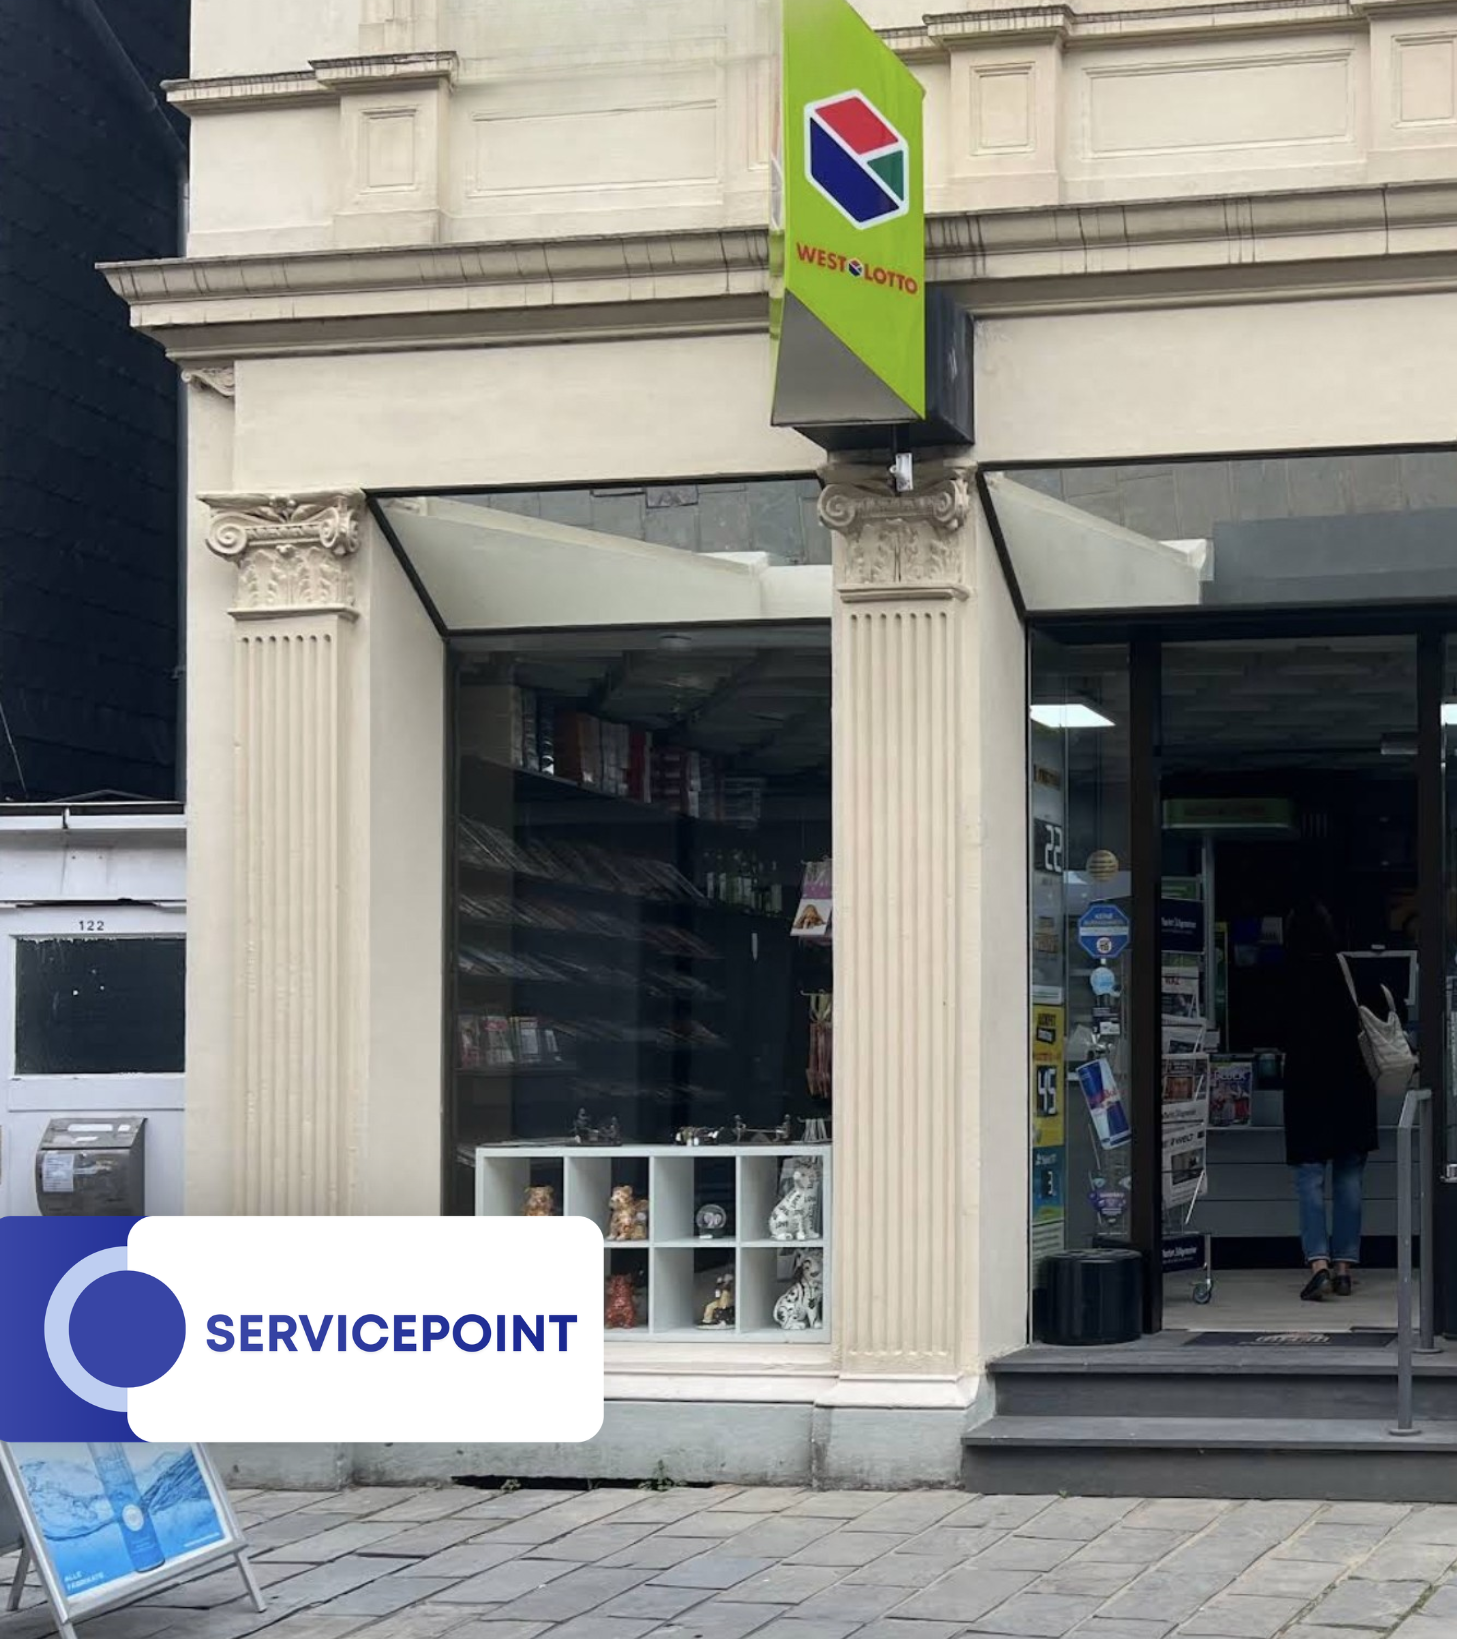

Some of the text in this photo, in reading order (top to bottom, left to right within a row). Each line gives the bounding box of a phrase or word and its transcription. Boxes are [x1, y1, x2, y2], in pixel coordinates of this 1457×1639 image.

[796, 241, 918, 294] WEST LOTTO
[78, 920, 105, 931] 122
